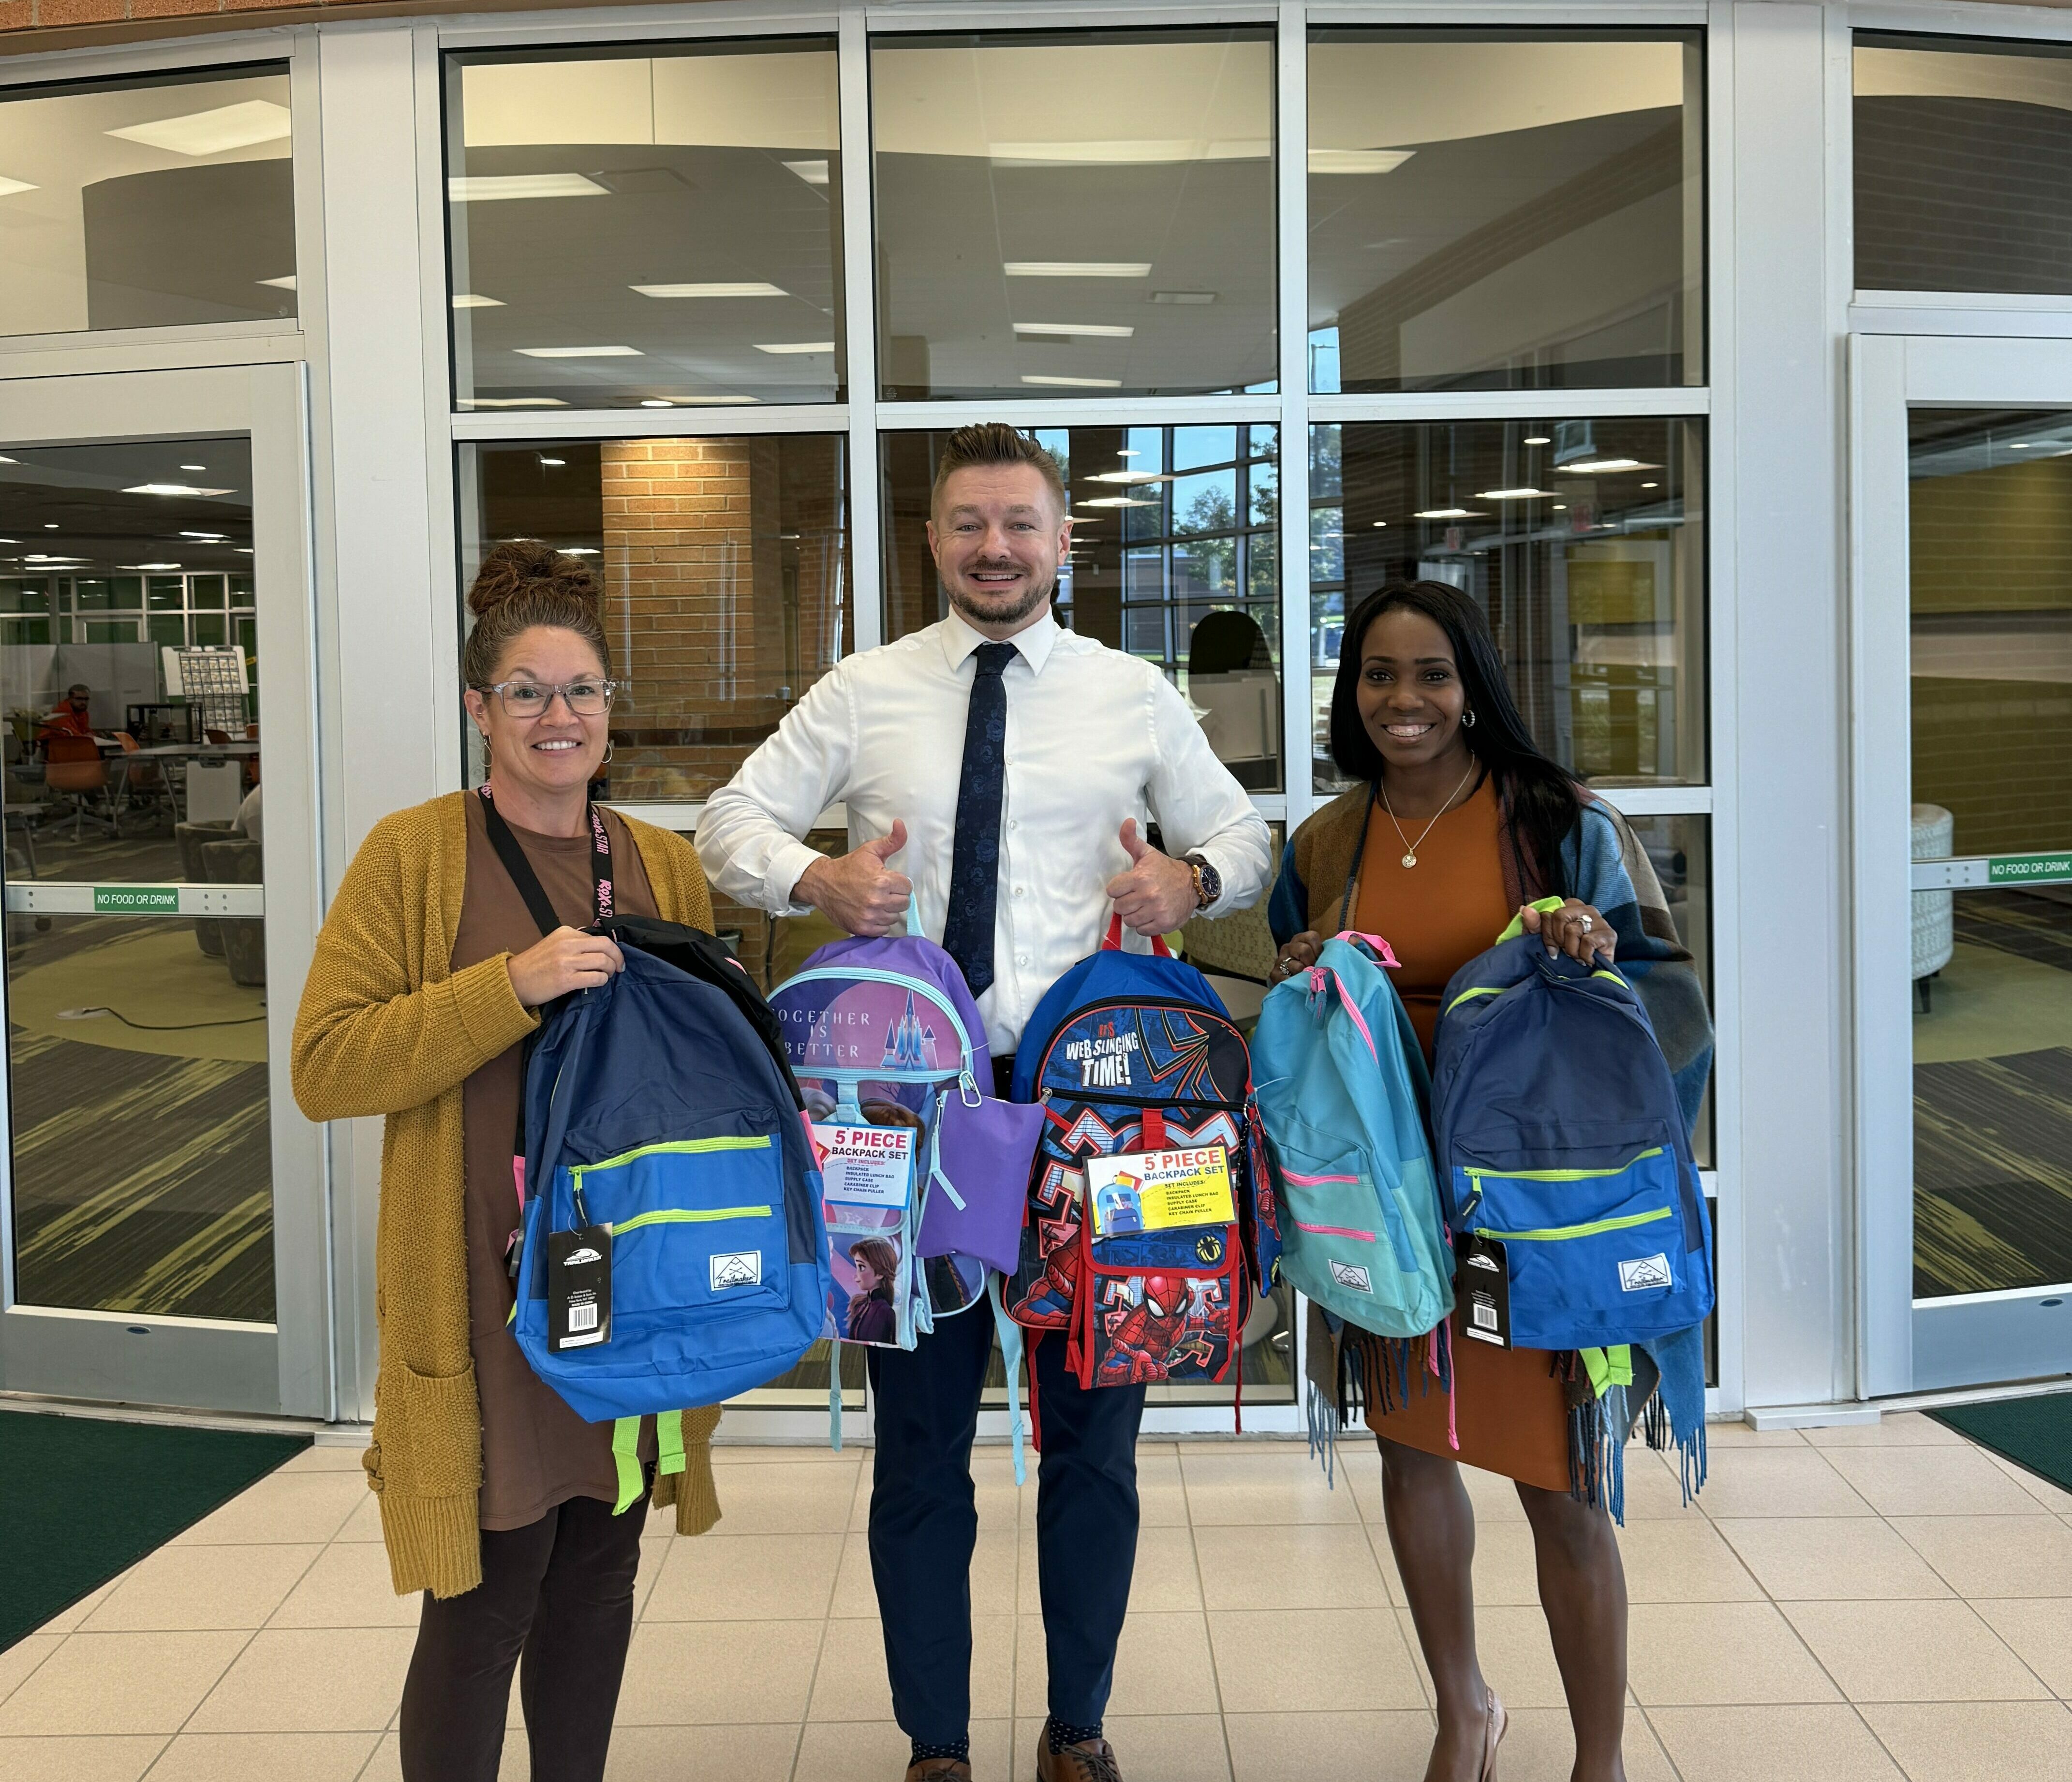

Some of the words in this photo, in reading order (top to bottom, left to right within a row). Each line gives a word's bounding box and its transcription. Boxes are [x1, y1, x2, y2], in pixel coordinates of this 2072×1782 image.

[1992, 865, 2005, 875] NO
[2006, 863, 2029, 874] FOOD
[2031, 862, 2044, 873] OR
[2045, 861, 2070, 872] DRINK
[97, 894, 110, 904] NO
[111, 895, 134, 904] FOOD
[136, 895, 148, 904] OR
[150, 895, 176, 905] DRINK
[772, 1009, 870, 1025] OGETHER
[810, 1025, 827, 1038] IS
[784, 1042, 858, 1058] BETTER
[1066, 1039, 1092, 1060] WEB
[1093, 1031, 1139, 1056] SLINGING
[1081, 1052, 1132, 1087] TIME!
[835, 1130, 846, 1144] 5
[852, 1132, 907, 1149] PIECE
[832, 1147, 886, 1158] BACKPACK
[888, 1151, 908, 1160] SET
[1145, 1156, 1155, 1170] 5
[1162, 1150, 1221, 1169] PIECE
[1144, 1168, 1201, 1180] BACKPACK
[1205, 1165, 1225, 1175] SET
